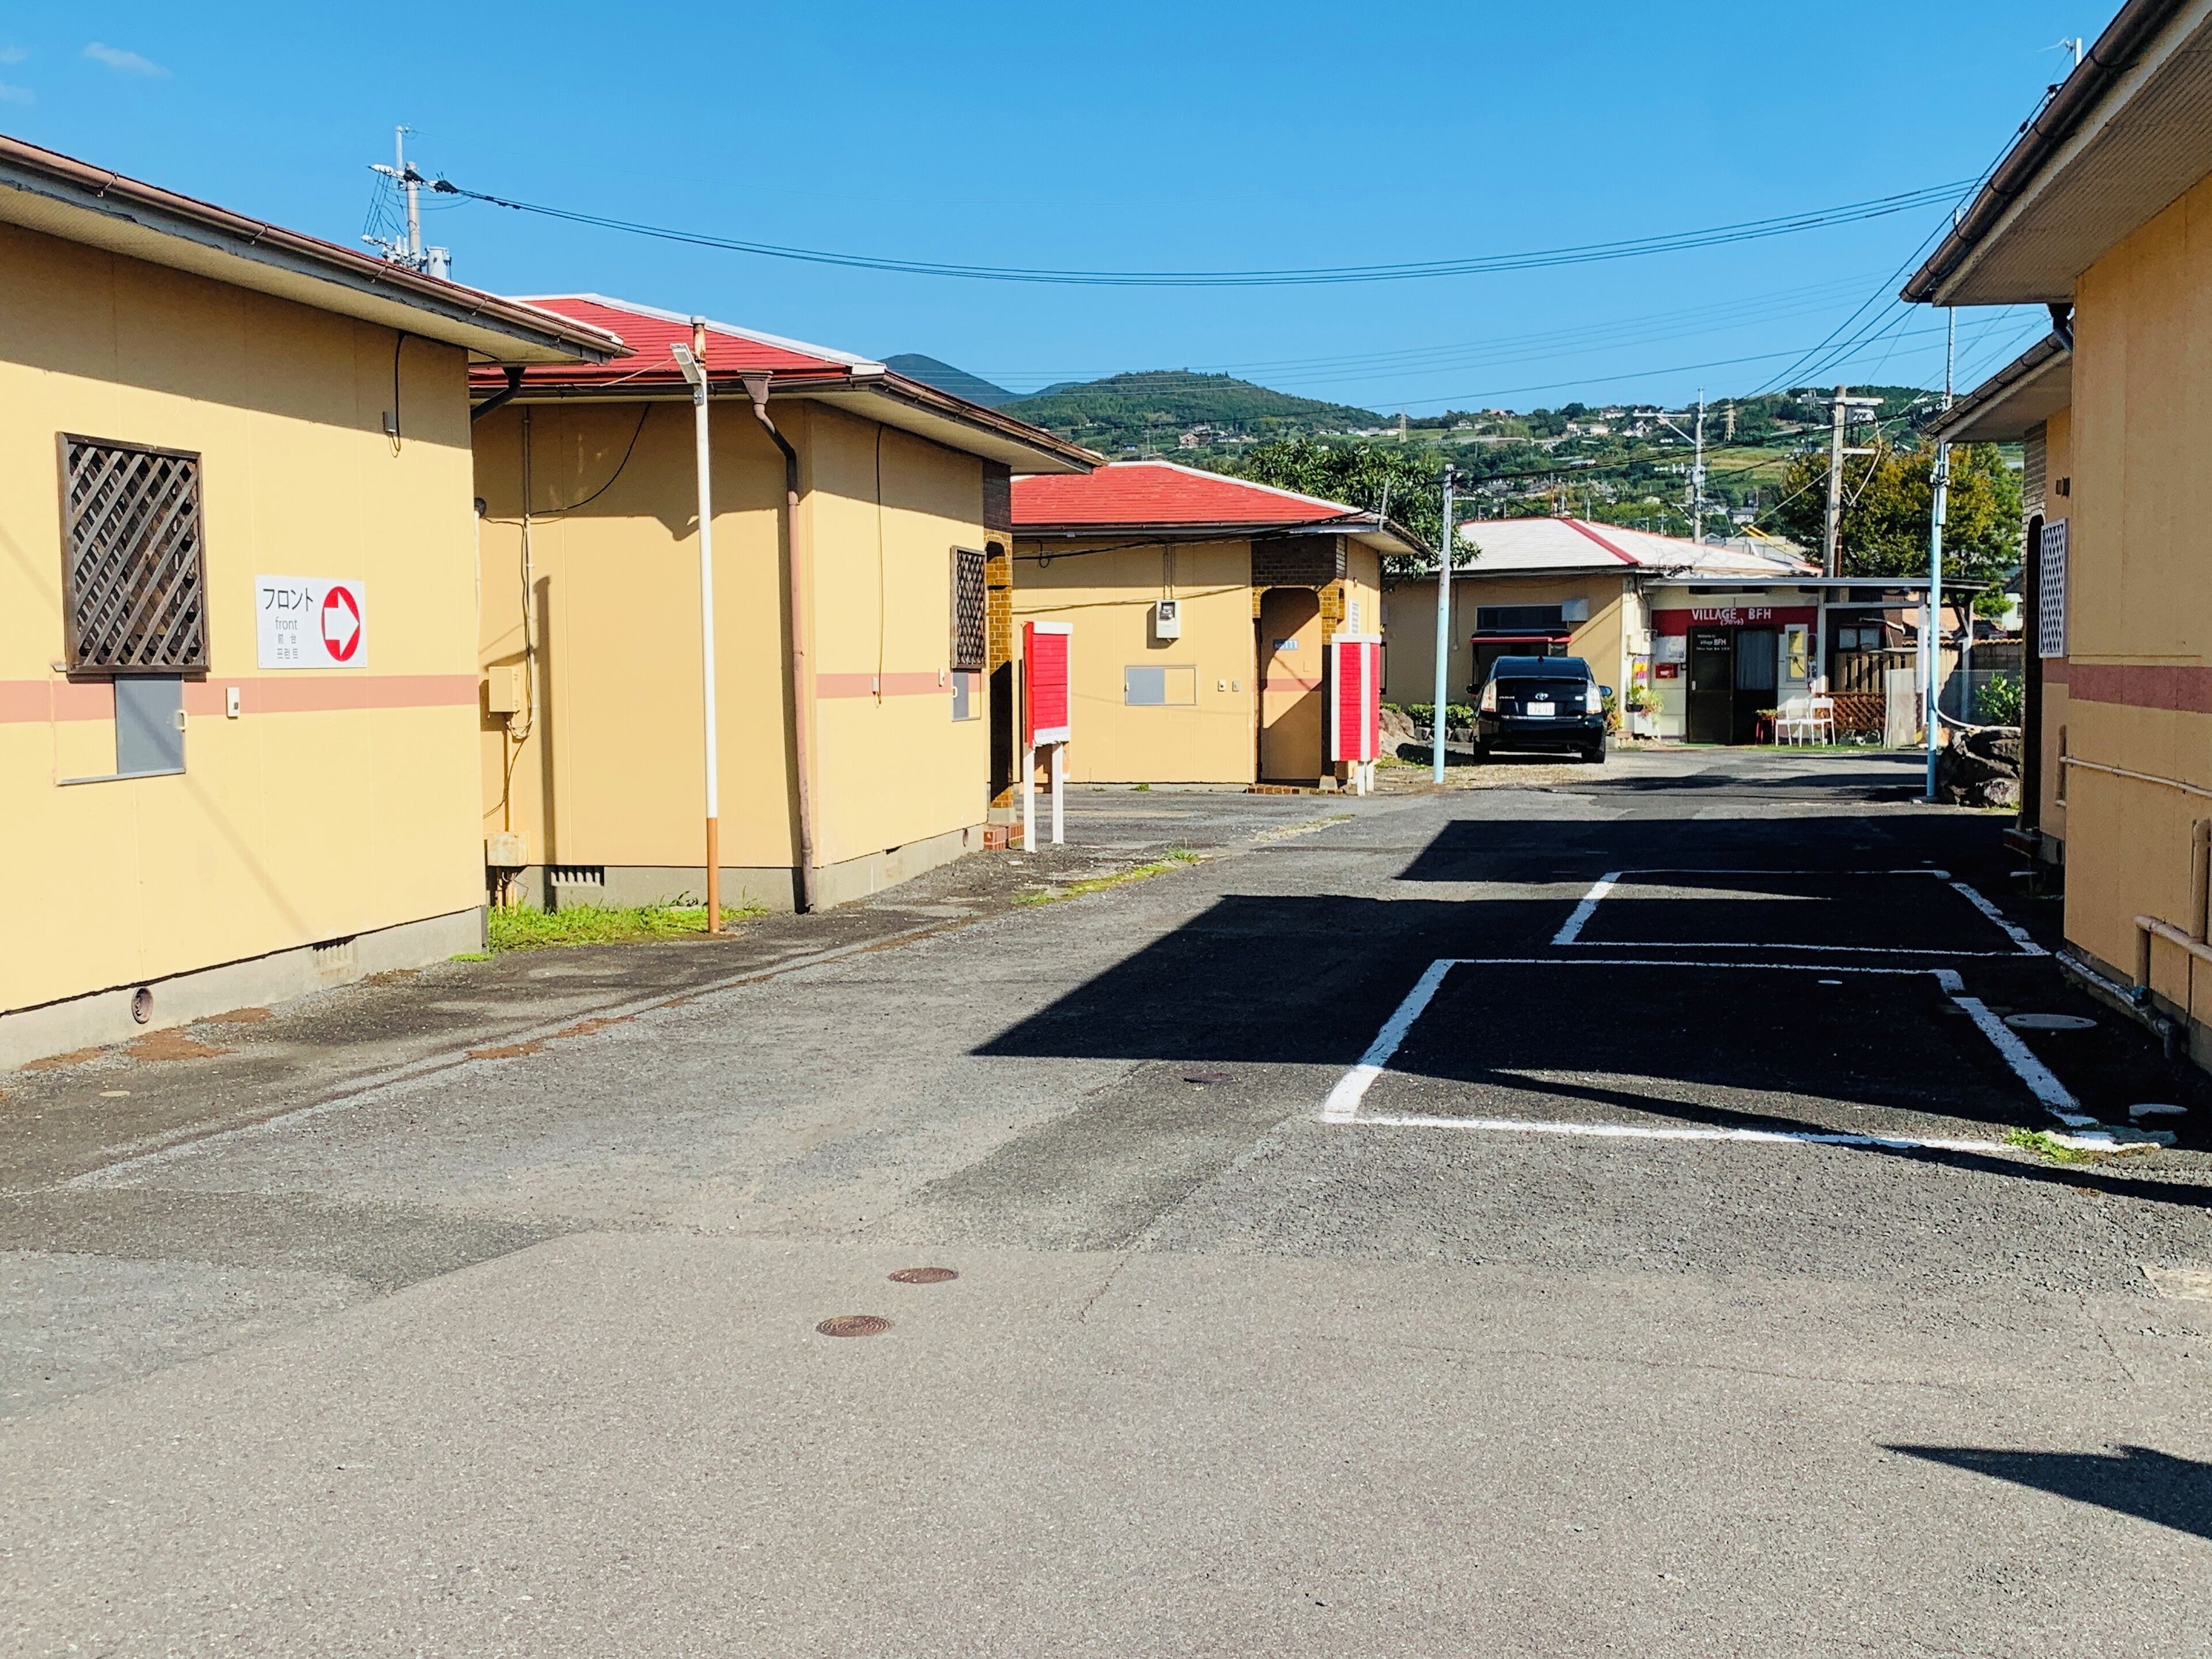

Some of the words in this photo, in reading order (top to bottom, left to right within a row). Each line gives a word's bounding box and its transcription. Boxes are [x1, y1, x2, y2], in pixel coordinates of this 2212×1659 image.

[263, 587, 313, 612] フロント
[1692, 608, 1737, 620] VILLAGE
[1748, 608, 1771, 620] BFH
[275, 616, 298, 630] front
[1285, 640, 1297, 649] 111
